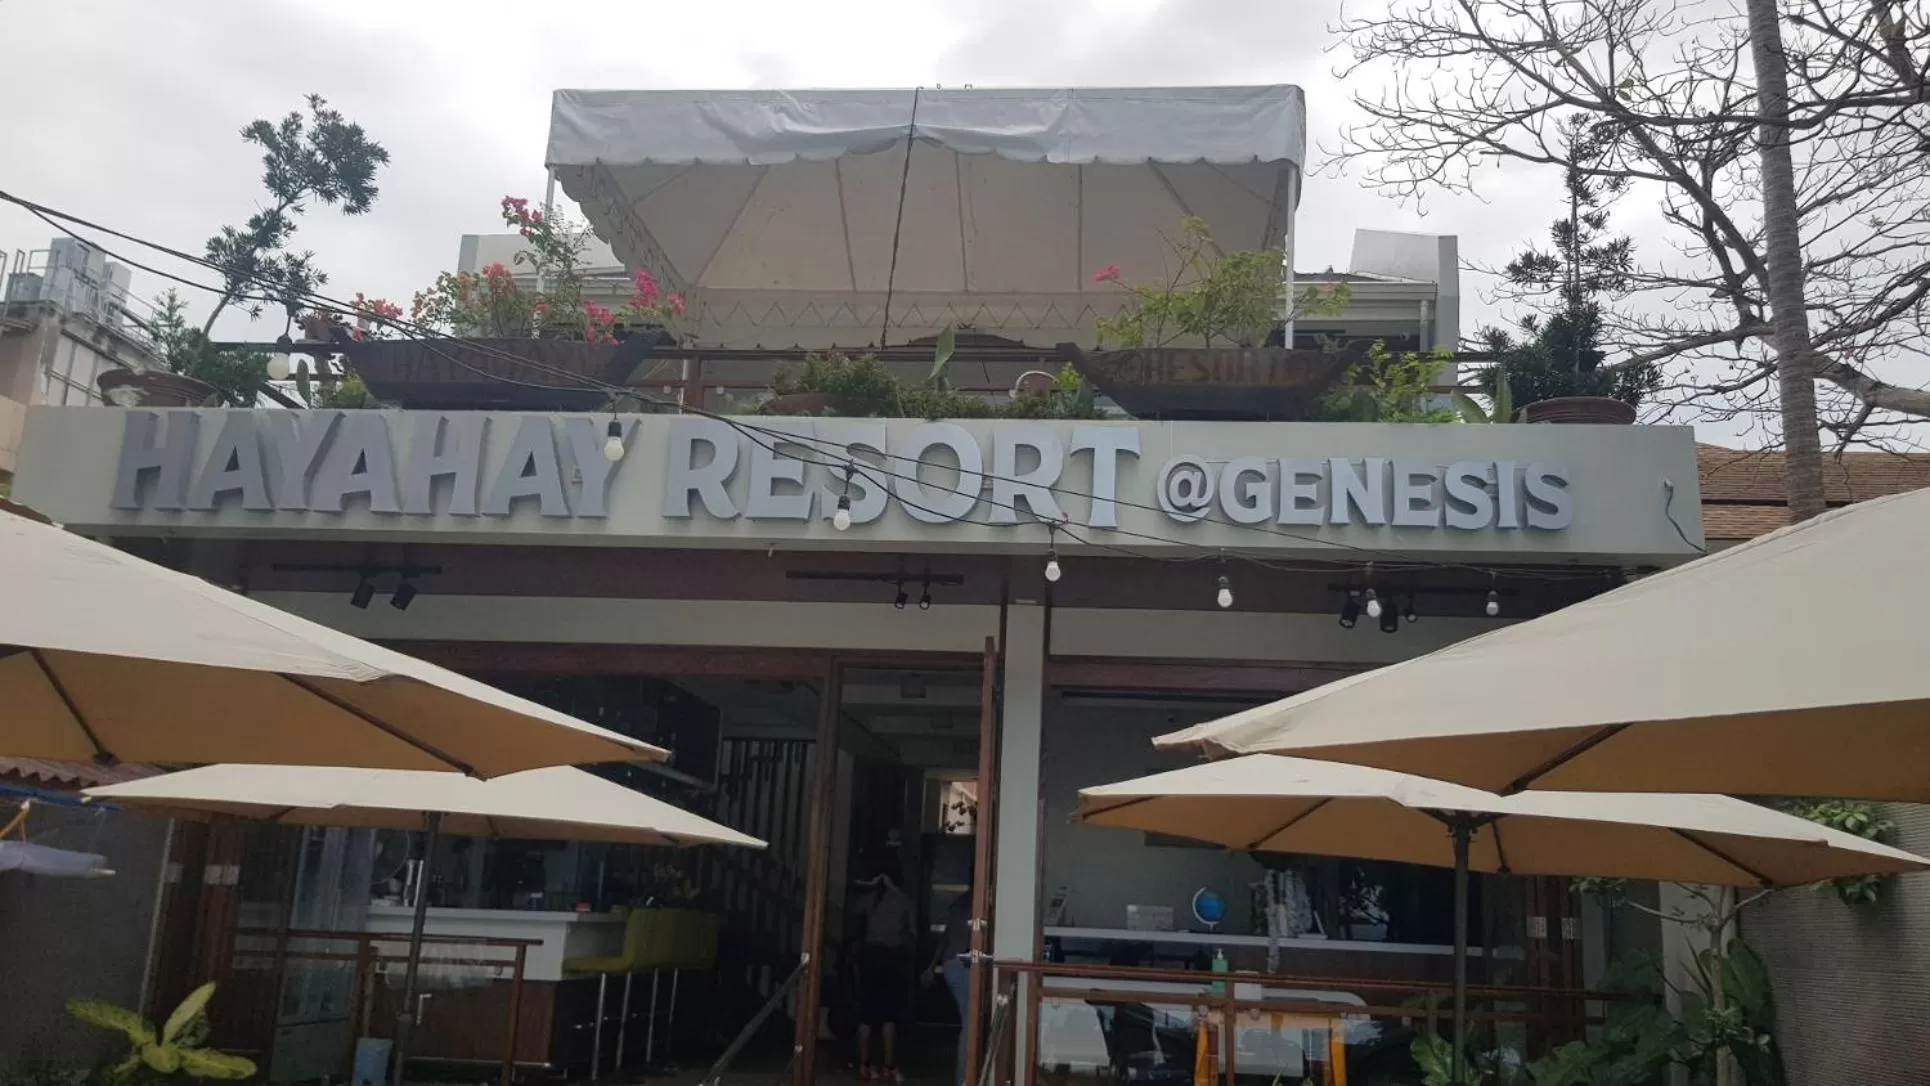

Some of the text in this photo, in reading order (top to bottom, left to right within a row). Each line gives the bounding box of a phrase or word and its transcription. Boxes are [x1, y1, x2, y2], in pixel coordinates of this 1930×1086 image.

[111, 411, 1573, 530] HAYAHAY RESORT @GENESIS
